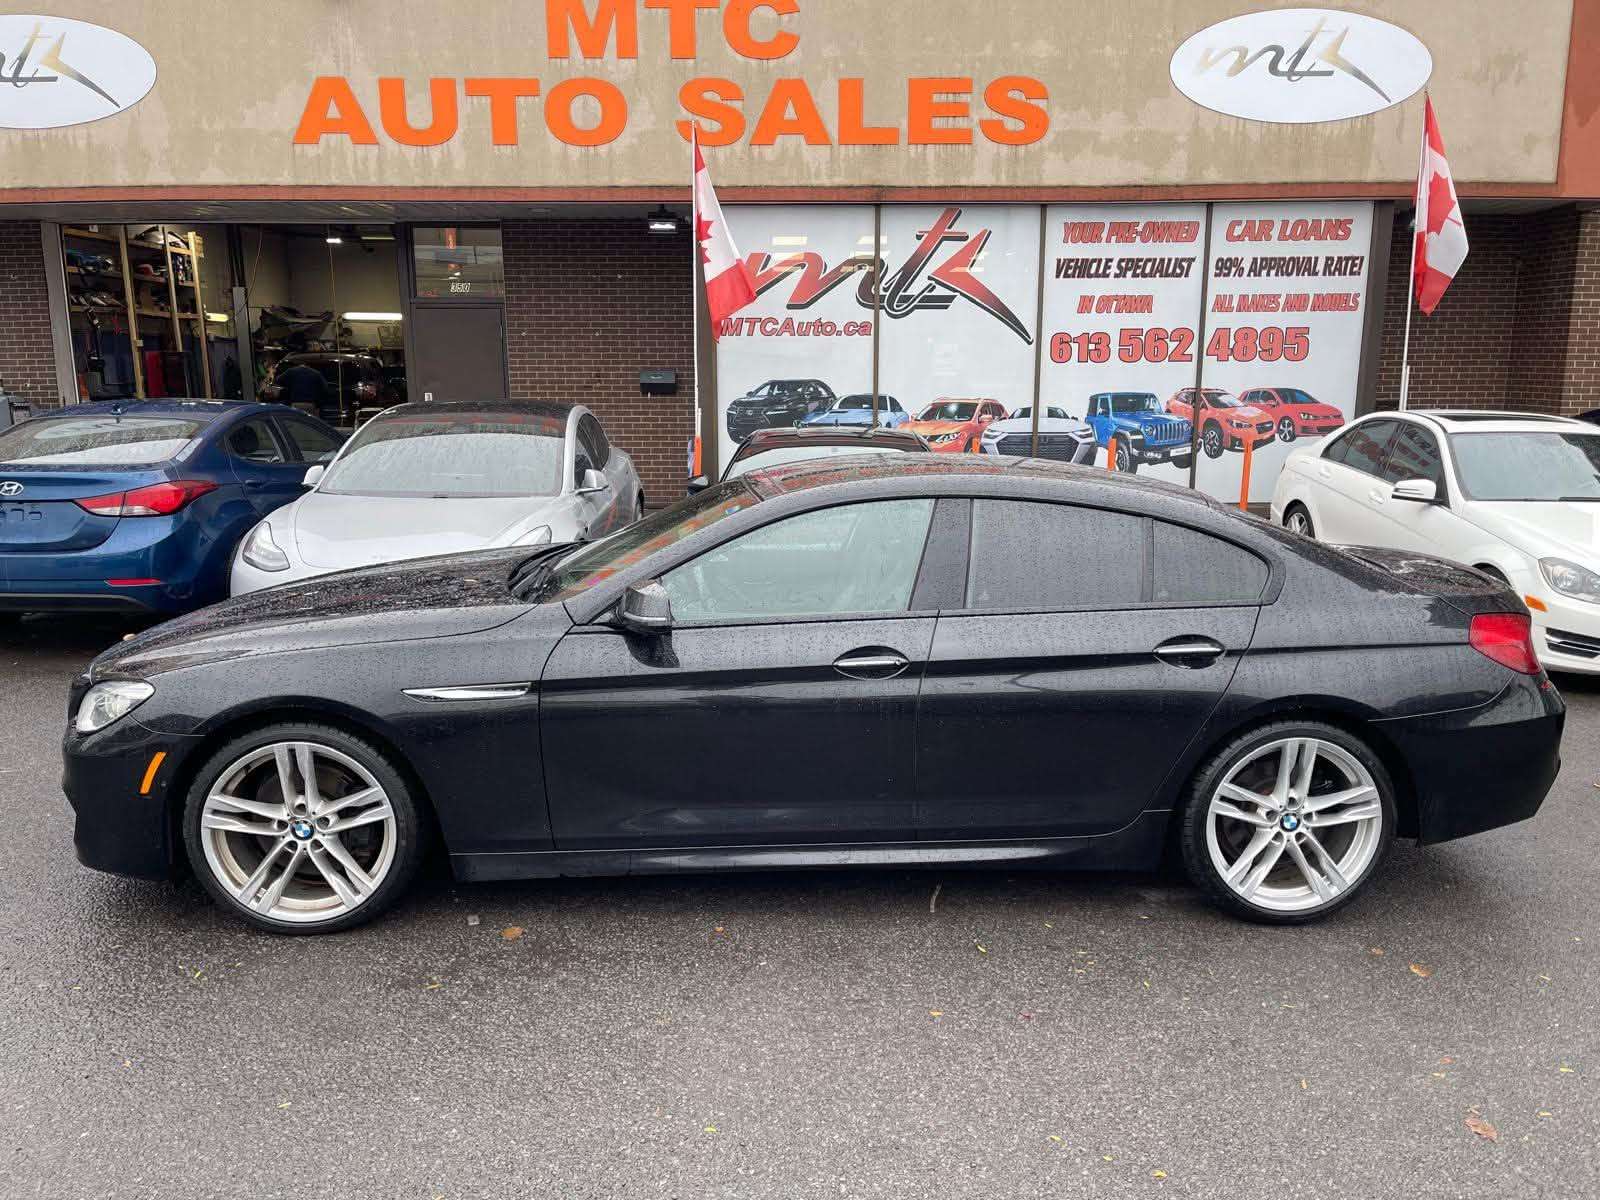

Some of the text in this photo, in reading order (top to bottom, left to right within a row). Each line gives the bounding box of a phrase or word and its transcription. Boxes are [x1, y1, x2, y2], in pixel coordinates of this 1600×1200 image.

[548, 0, 798, 58] MTC
[296, 77, 1049, 146] AUTO SALES
[1063, 220, 1200, 244] YOUR PRE-OWNED
[1225, 218, 1354, 243] CAR LOANS
[1055, 256, 1197, 279] VEHICLE SPECIALIST
[1213, 255, 1365, 278] 99% APPROVAL RATE!
[1076, 294, 1154, 314] IN OTTAWA
[1212, 292, 1361, 313] ALL MAKES AND MODELS
[720, 317, 874, 337] MTCAuto.ca
[1050, 326, 1311, 364] 613 562 4895
